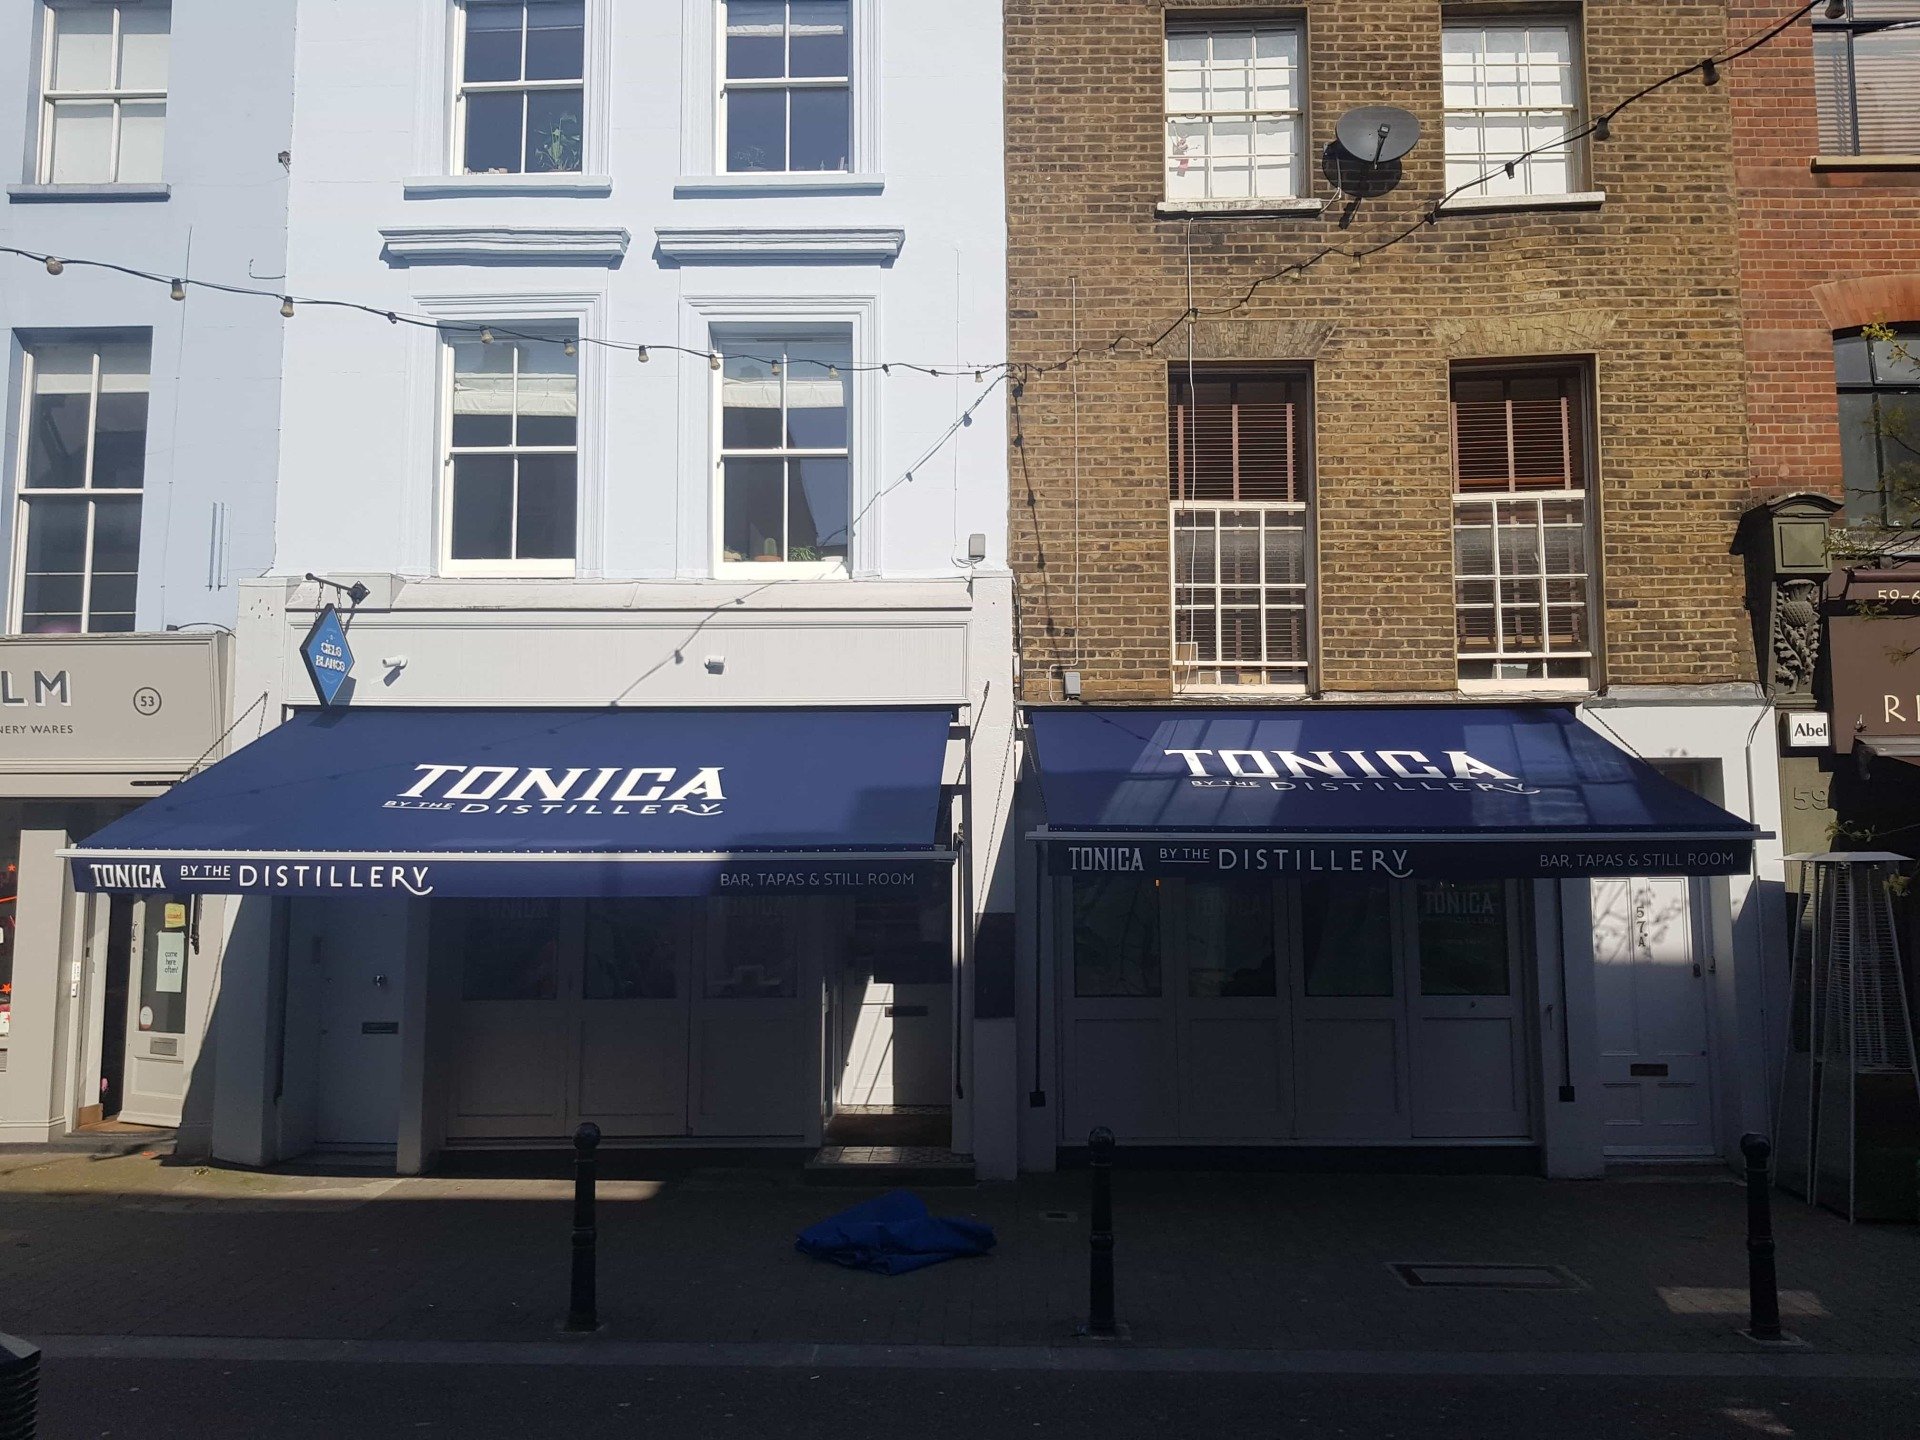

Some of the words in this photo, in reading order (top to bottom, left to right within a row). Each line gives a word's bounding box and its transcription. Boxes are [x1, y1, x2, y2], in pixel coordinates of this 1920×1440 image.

[140, 695, 155, 707] 53
[30, 724, 74, 735] WARES
[1794, 722, 1827, 737] Abel
[1164, 749, 1519, 780] TONICA
[397, 764, 727, 801] TONICA
[1271, 781, 1541, 795] DISTILLERY
[1793, 786, 1829, 811] 59
[384, 800, 406, 808] BY
[418, 801, 456, 809] THE
[459, 803, 724, 816] DISTILLERY
[1068, 847, 1145, 871] TONICA
[1160, 848, 1177, 860] BY
[1183, 848, 1210, 860] THE
[1218, 848, 1414, 878] DISTILLERY
[1540, 854, 1573, 868] BAR,
[1576, 853, 1624, 867] TAPAS
[1627, 853, 1639, 867] &
[1642, 853, 1684, 866] STILL
[1687, 852, 1735, 866] ROOM
[90, 863, 167, 889] TONICA
[180, 865, 197, 877] BY
[204, 865, 231, 877] THE
[239, 865, 434, 896] DISTILLERY
[720, 873, 754, 887] BAR,
[757, 873, 805, 886] TAPAS
[808, 873, 820, 886] &
[823, 872, 864, 885] STILL
[868, 872, 915, 885] ROOM
[1423, 891, 1494, 914] TONICA
